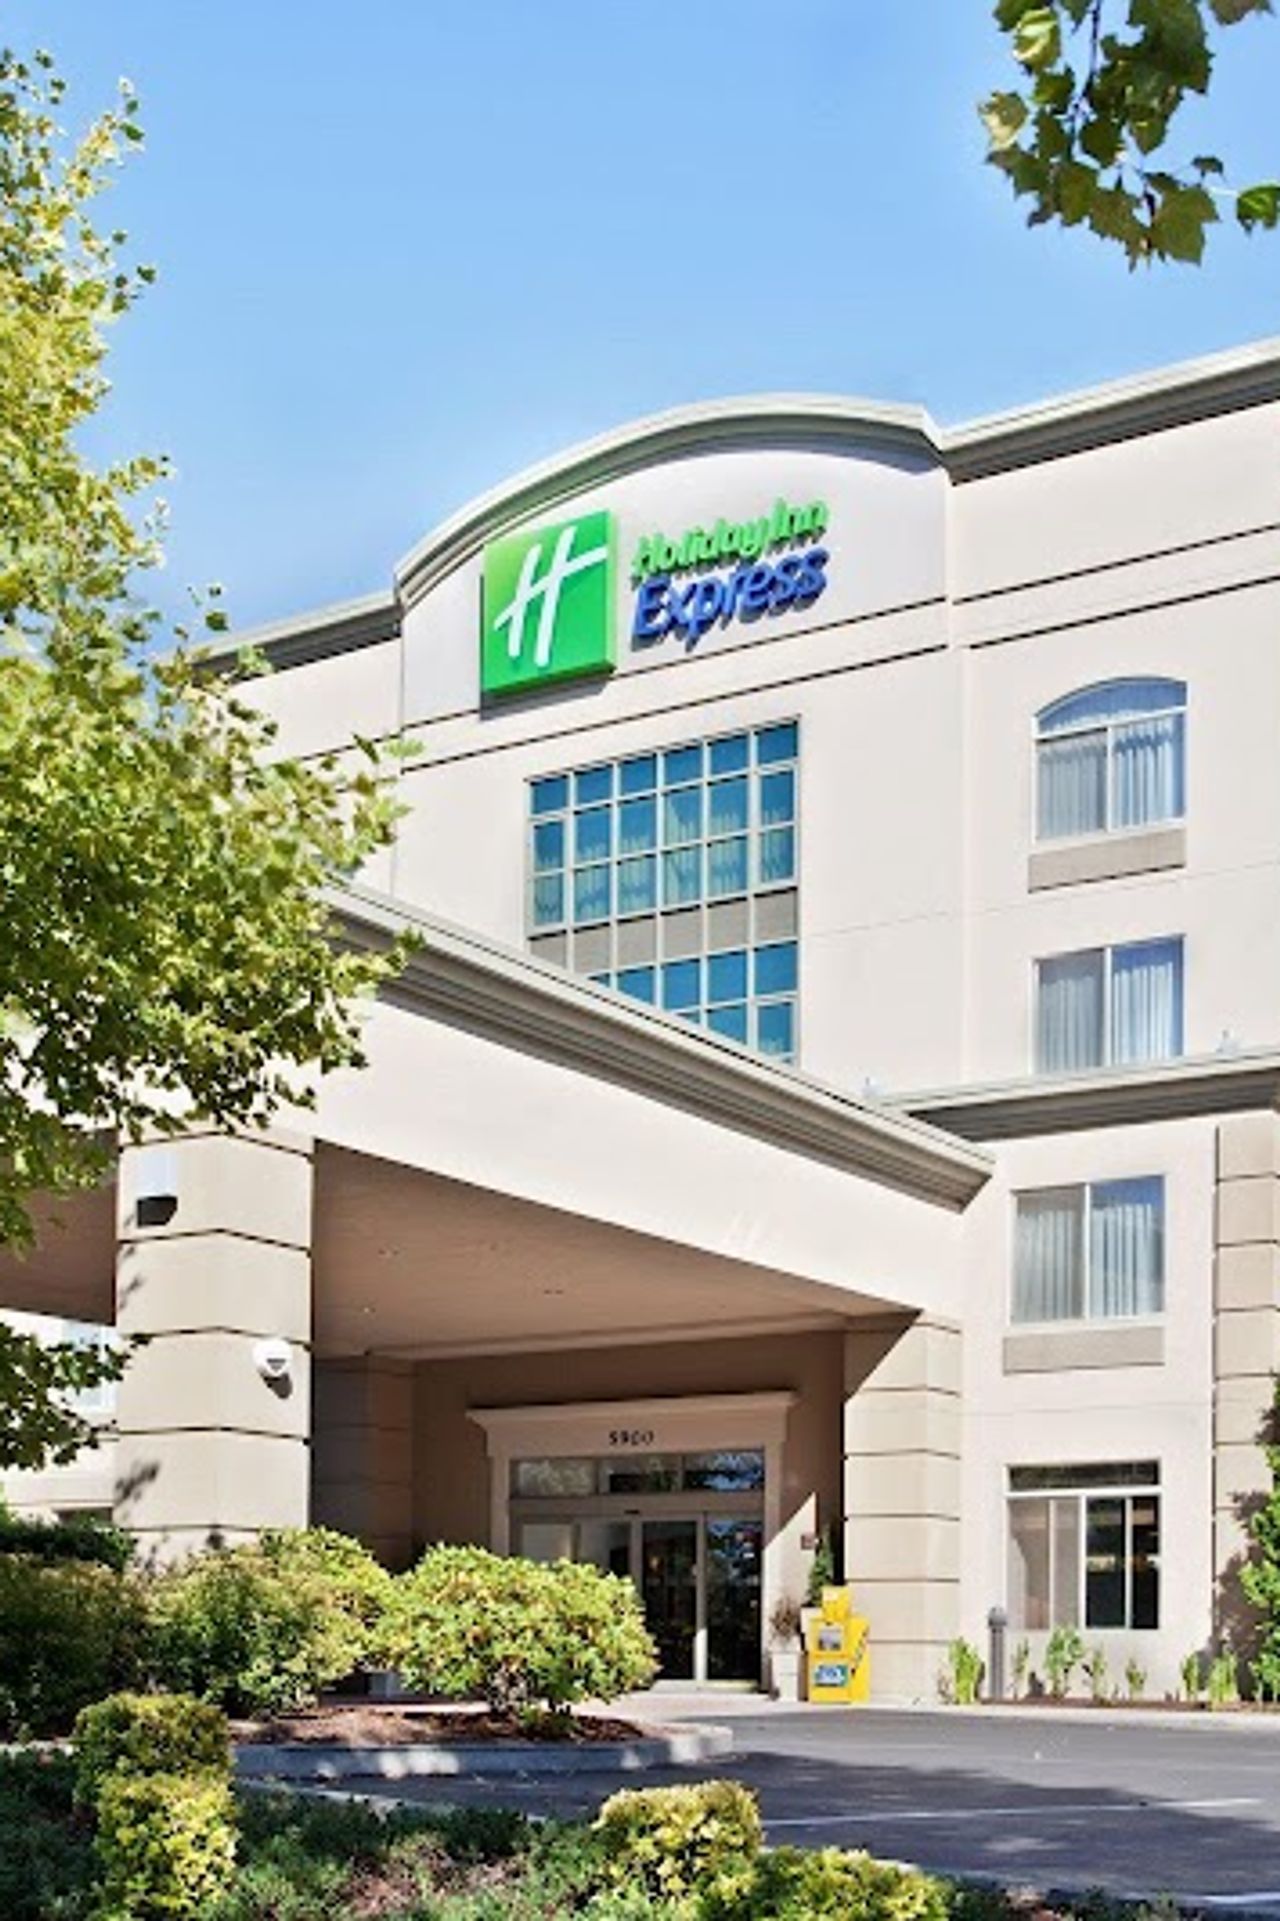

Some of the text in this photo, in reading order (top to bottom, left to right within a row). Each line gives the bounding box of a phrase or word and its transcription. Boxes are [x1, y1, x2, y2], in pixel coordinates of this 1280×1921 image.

[632, 497, 830, 580] Holiday Inn
[632, 547, 830, 648] Express
